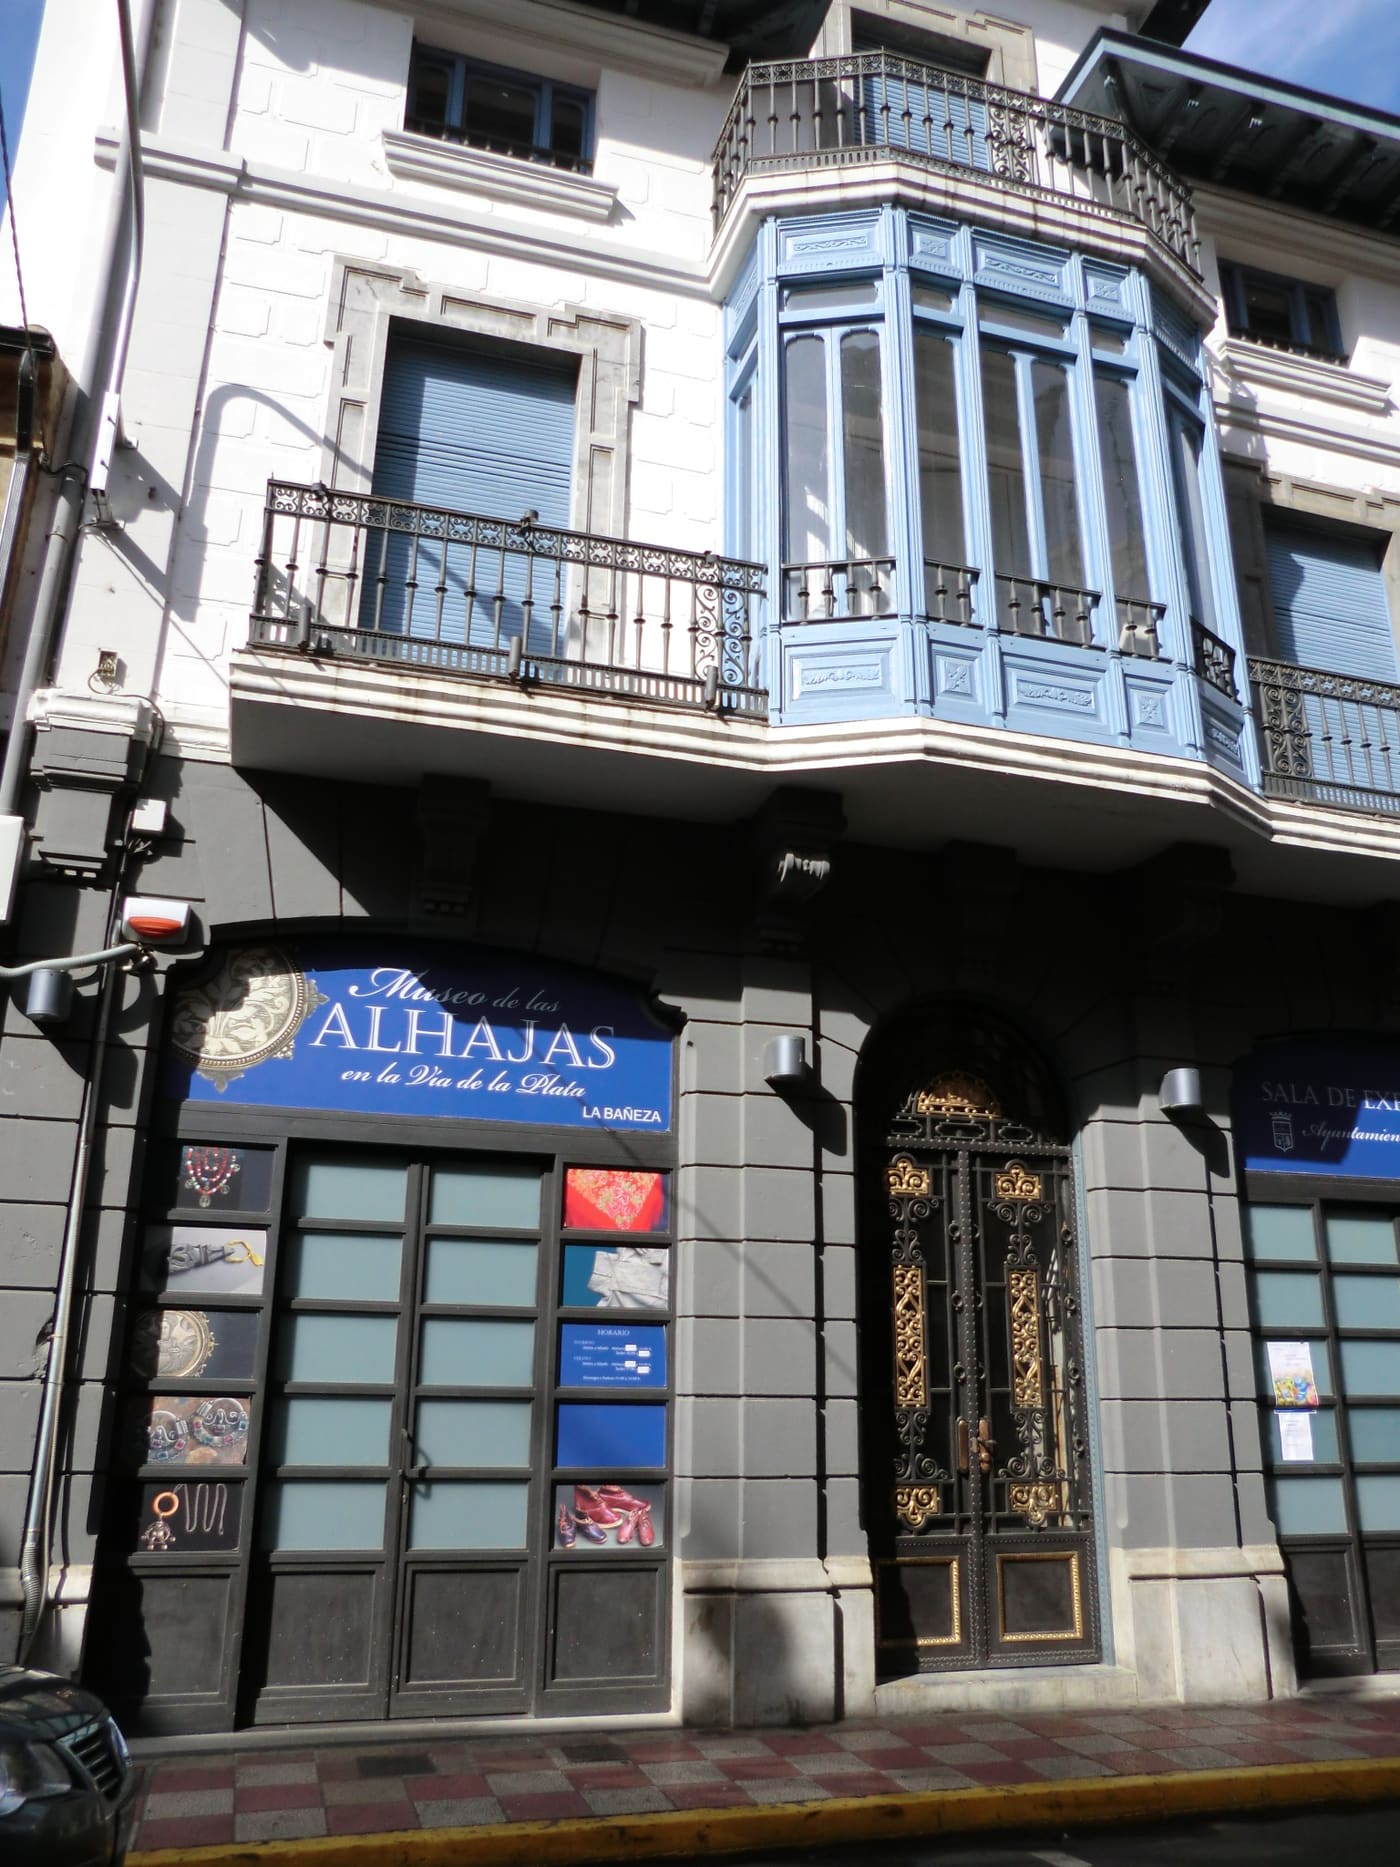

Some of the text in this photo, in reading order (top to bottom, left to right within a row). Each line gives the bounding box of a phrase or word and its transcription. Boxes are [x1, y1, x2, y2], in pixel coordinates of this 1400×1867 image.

[349, 967, 560, 1013] Museo de las
[309, 1002, 616, 1069] ALHAJAS
[341, 1067, 372, 1082] en
[376, 1061, 400, 1085] la
[456, 1068, 483, 1091] de
[488, 1069, 512, 1092] la
[516, 1072, 586, 1098] Plata
[1261, 1080, 1319, 1105] SALA
[1328, 1086, 1357, 1108] DE
[582, 1105, 662, 1123] LA BAÑEZA
